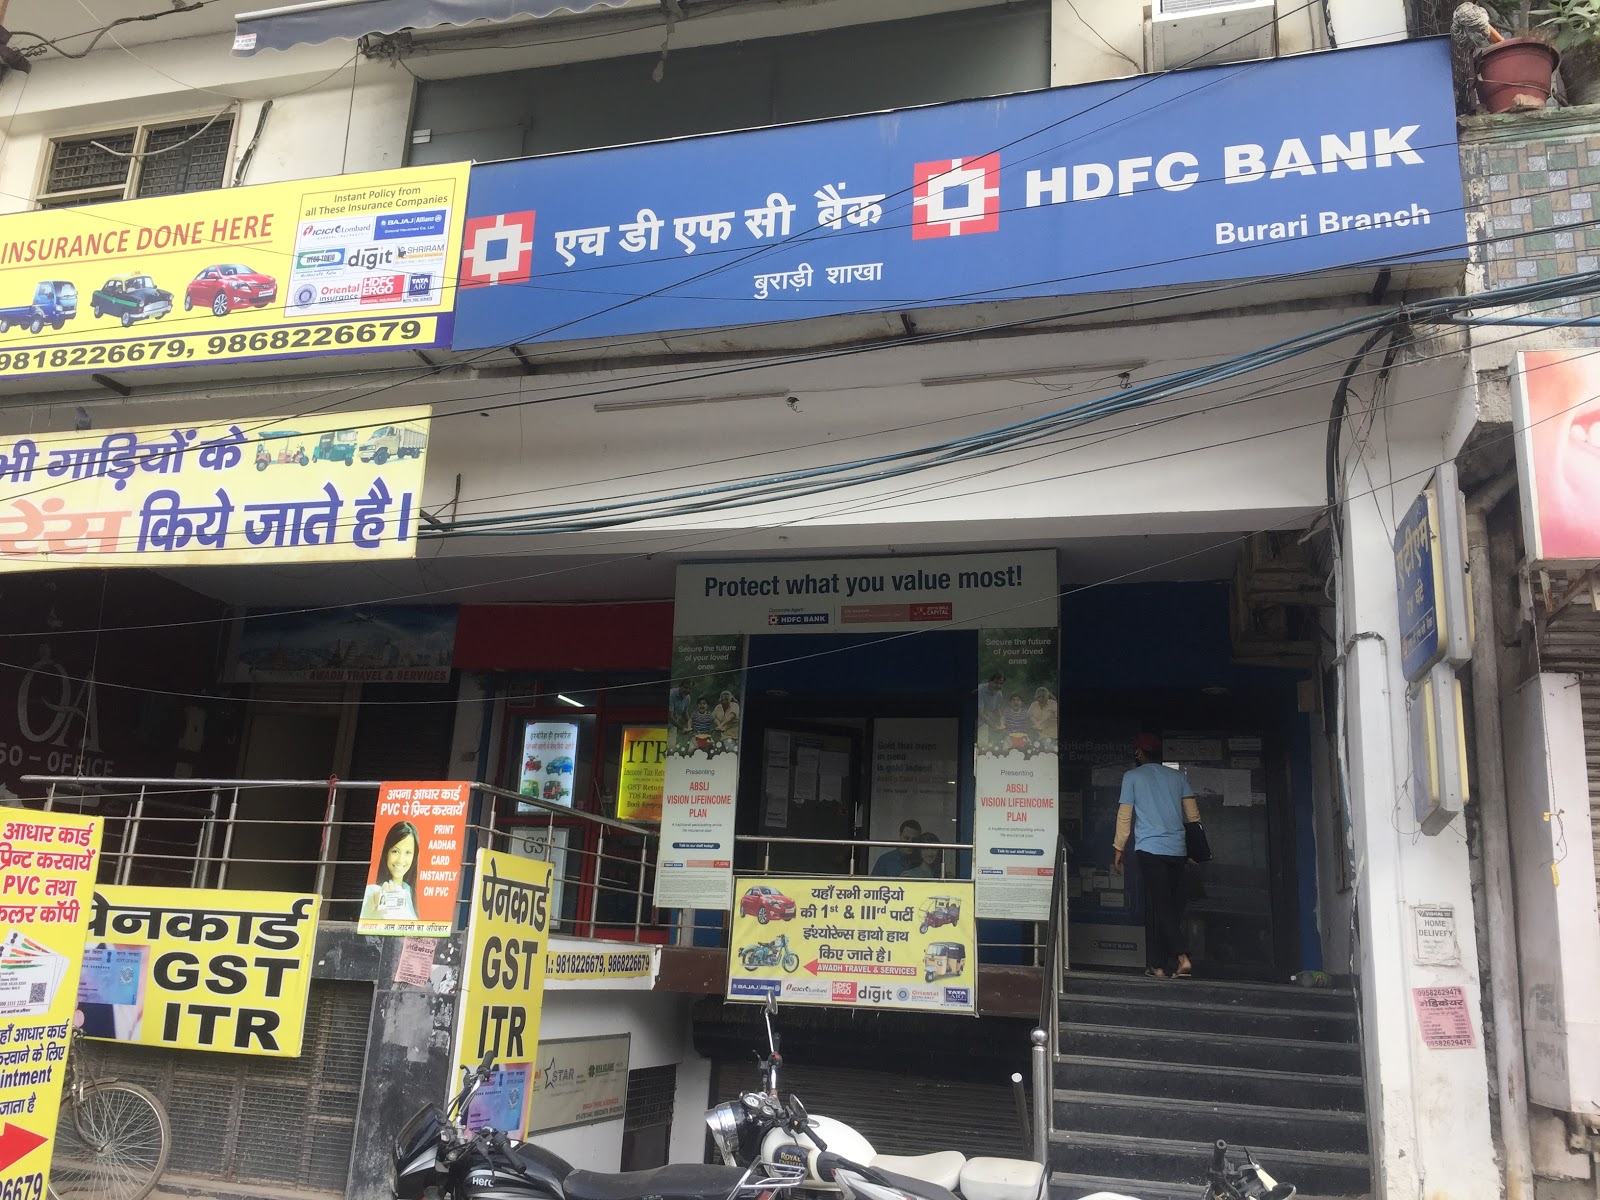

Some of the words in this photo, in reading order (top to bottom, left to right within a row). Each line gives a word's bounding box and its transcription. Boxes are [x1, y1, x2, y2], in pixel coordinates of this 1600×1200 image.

[1025, 151, 1199, 208] HDFC
[1223, 124, 1425, 185] BANK
[334, 192, 366, 203] Instant
[369, 189, 396, 200] Policy
[398, 186, 421, 196] from
[305, 208, 316, 217] all
[319, 204, 345, 215] These
[348, 200, 393, 212] Insurance
[395, 194, 448, 207] Companies
[387, 218, 414, 226] BAJAJ
[555, 225, 610, 267] एच
[619, 208, 664, 252] डी
[674, 211, 735, 255] एफ
[745, 192, 796, 240] सी
[813, 181, 887, 230] बैंक
[1215, 214, 1308, 245] Burari
[1319, 203, 1431, 235] Branch
[1, 229, 131, 264] INSURANCE
[136, 221, 205, 251] DONE
[211, 213, 274, 242] HERE
[312, 227, 334, 237] ICICI
[341, 224, 371, 234] Lombard
[407, 244, 445, 254] SHRIRAM
[348, 247, 393, 270] digit
[364, 276, 394, 287] HDFC
[754, 263, 814, 299] बुराड़ी
[827, 262, 884, 285] शाखा
[321, 283, 360, 295] Oriental
[362, 285, 394, 296] ERGO
[0, 339, 195, 371] 9818226679,
[207, 320, 422, 355] 9868226679
[46, 429, 198, 491] गाड़ियों
[199, 425, 249, 471] के
[137, 488, 236, 553] किये
[244, 481, 344, 548] जाते
[705, 571, 779, 597] Protect
[786, 573, 839, 595] what
[847, 576, 884, 597] you
[891, 569, 951, 591] value
[958, 565, 1023, 589] most!
[678, 645, 703, 653] Secure
[716, 644, 737, 652] future
[1028, 637, 1052, 645] future
[710, 653, 729, 661] loved
[1022, 647, 1044, 655] loved
[309, 670, 344, 681] AWADH
[347, 670, 382, 681] TRAVEL
[385, 671, 394, 680] &
[397, 670, 447, 681] SERVICES
[48, 751, 115, 777] OFFICE
[387, 789, 412, 800] अपना
[413, 789, 440, 801] आधार
[441, 785, 462, 801] कार्ड
[689, 781, 710, 791] ABSLI
[1006, 783, 1028, 793] ABSLI
[667, 794, 689, 805] VISION
[691, 794, 732, 805] LIFEINCOME
[981, 797, 1006, 808] VISION
[1008, 797, 1054, 809] LIFEINCOME
[380, 803, 400, 816] PVC
[689, 808, 708, 818] PLAN
[1007, 812, 1027, 822] PLAN
[3, 822, 56, 843] आधार
[58, 822, 94, 847] कार्ड
[434, 824, 454, 835] PRINT
[428, 839, 457, 850] AADHAR
[36, 848, 96, 871] करवायें
[431, 855, 450, 865] CARD
[419, 871, 458, 882] INSTANTLY
[3, 875, 41, 895] PVC
[45, 879, 77, 896] तथा
[423, 887, 433, 897] ON
[433, 887, 450, 897] PVC
[811, 885, 835, 901] यहाँ
[836, 885, 861, 901] सभी
[482, 857, 553, 933] पेनकार्ड
[40, 899, 80, 923] कॉपी
[800, 905, 817, 918] की
[843, 906, 855, 919] &
[890, 906, 915, 922] पार्टी
[1424, 920, 1446, 928] HOME
[857, 926, 884, 942] हाथो
[886, 929, 910, 942] हाथ
[819, 944, 843, 961] किए
[847, 947, 873, 961] जाते
[482, 935, 539, 991] GST
[556, 954, 606, 977] 9818226679,
[608, 954, 650, 973] 9868226679
[817, 963, 843, 972] AWADH
[844, 964, 872, 973] TRAVEL
[880, 966, 916, 975] SERVICES
[154, 952, 301, 998] GST
[858, 986, 892, 1002] digit
[14, 1026, 46, 1043] आधार
[46, 1019, 70, 1039] कार्ड
[163, 1002, 280, 1051] ITR
[477, 1005, 527, 1059] ITR
[32, 1043, 44, 1063] के
[45, 1041, 66, 1062] लिए
[552, 1068, 575, 1083] STAR
[27, 1092, 37, 1113] है
[781, 1152, 802, 1162] ROYAL
